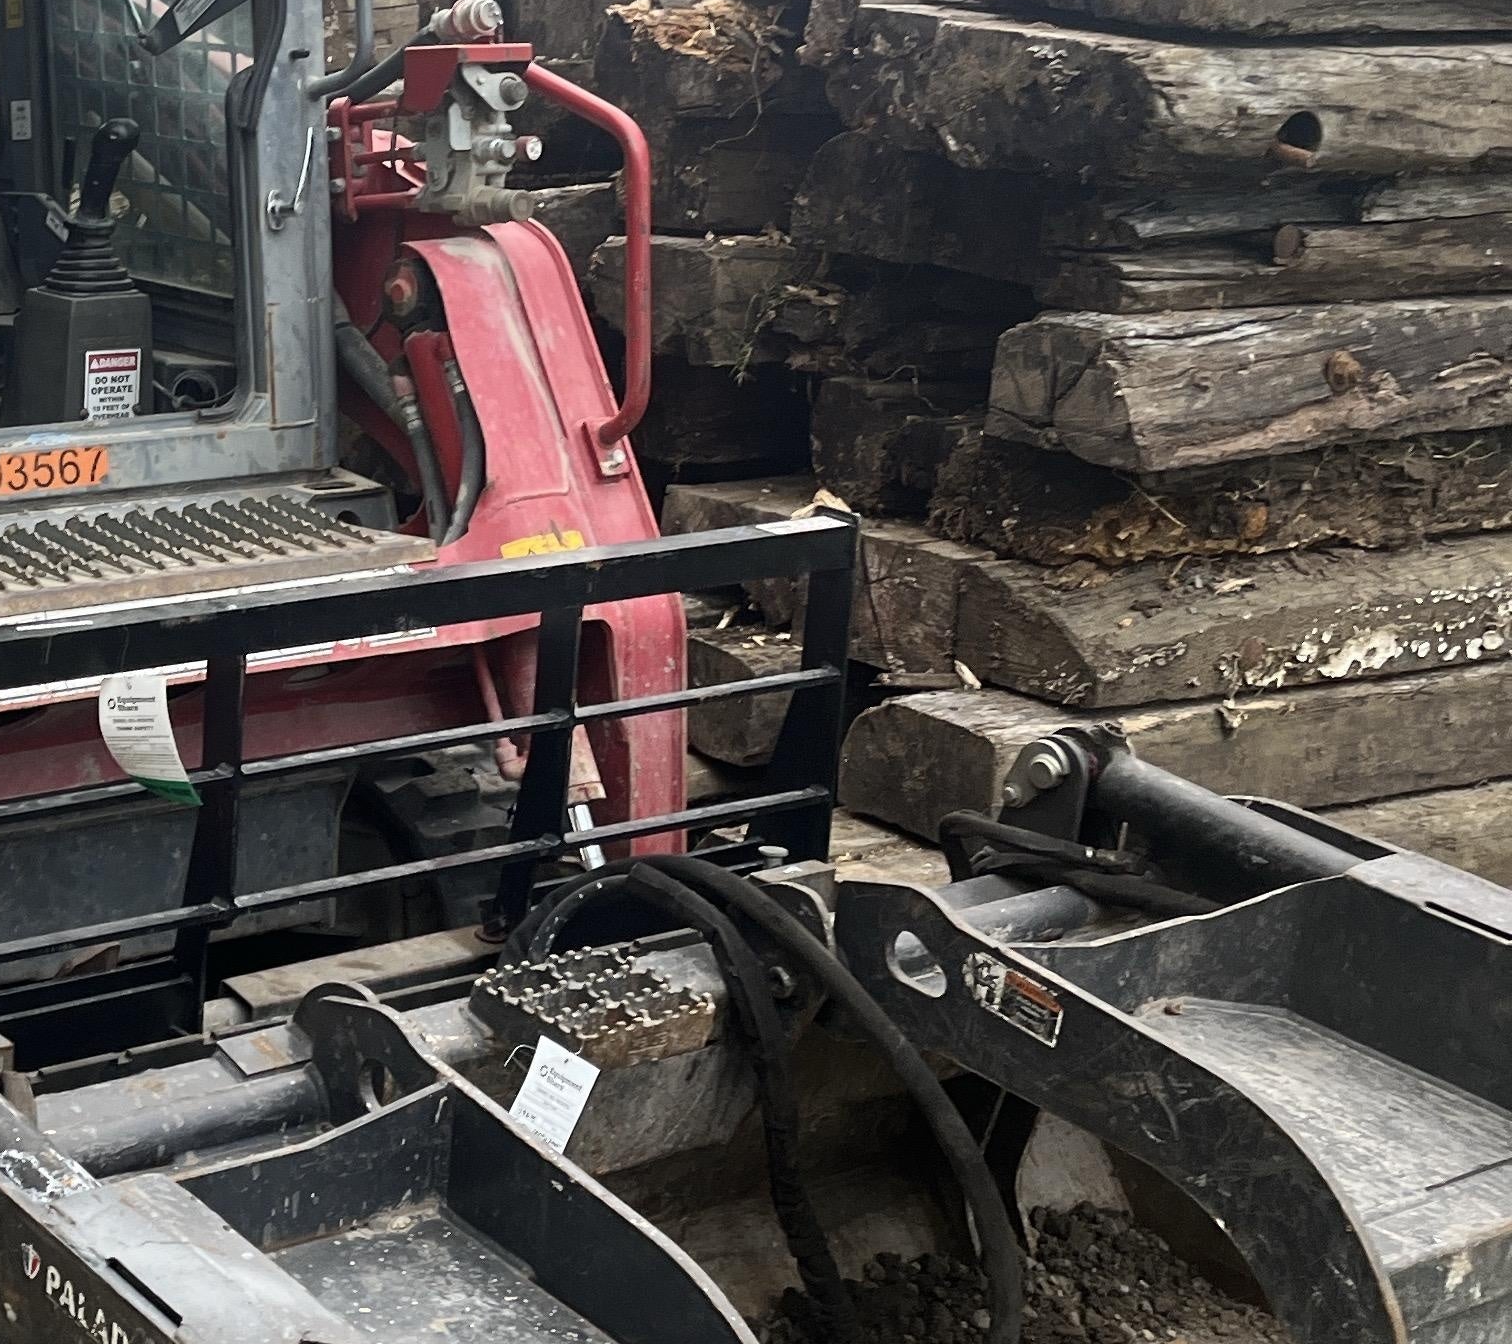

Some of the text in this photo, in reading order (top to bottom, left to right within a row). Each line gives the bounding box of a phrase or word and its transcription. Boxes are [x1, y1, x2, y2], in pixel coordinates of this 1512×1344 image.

[95, 374, 130, 384] DO NOT
[91, 384, 134, 395] OPERATE
